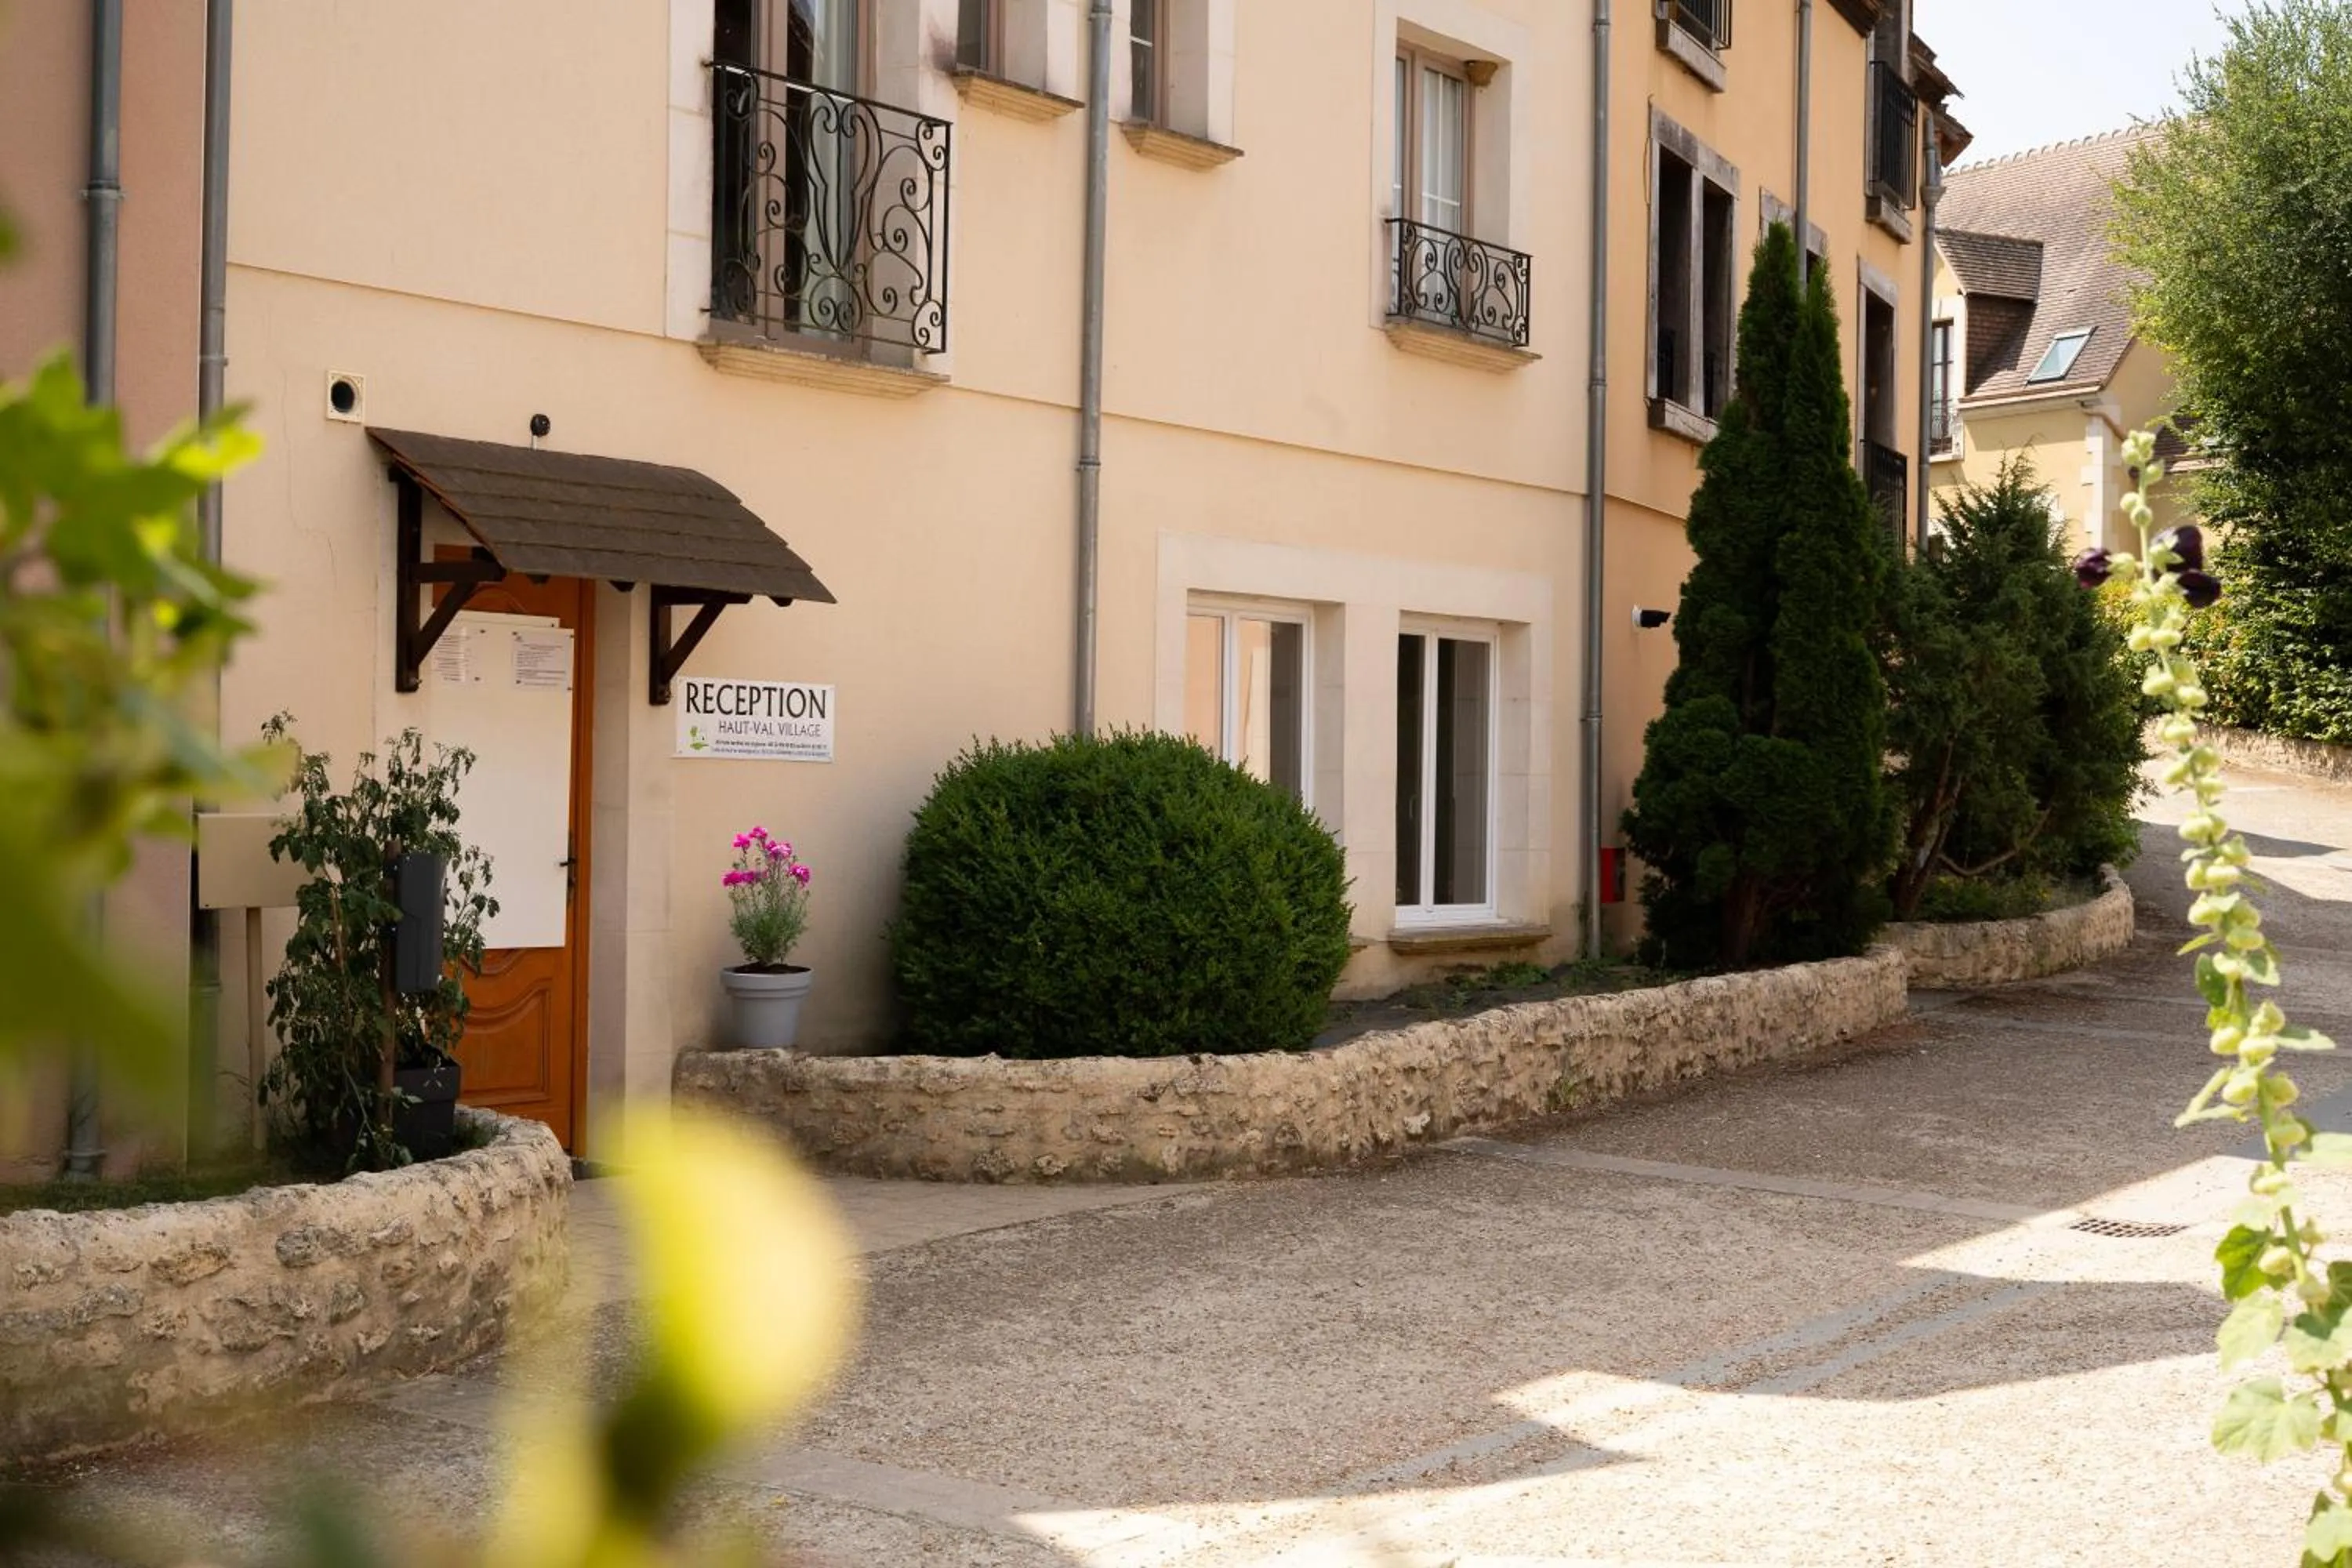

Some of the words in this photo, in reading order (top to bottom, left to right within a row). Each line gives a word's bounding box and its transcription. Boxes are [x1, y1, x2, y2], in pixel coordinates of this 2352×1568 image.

[686, 682, 826, 719] RECEPTION
[719, 720, 774, 736] HAUT-VAL
[778, 722, 821, 737] VILLAGE
